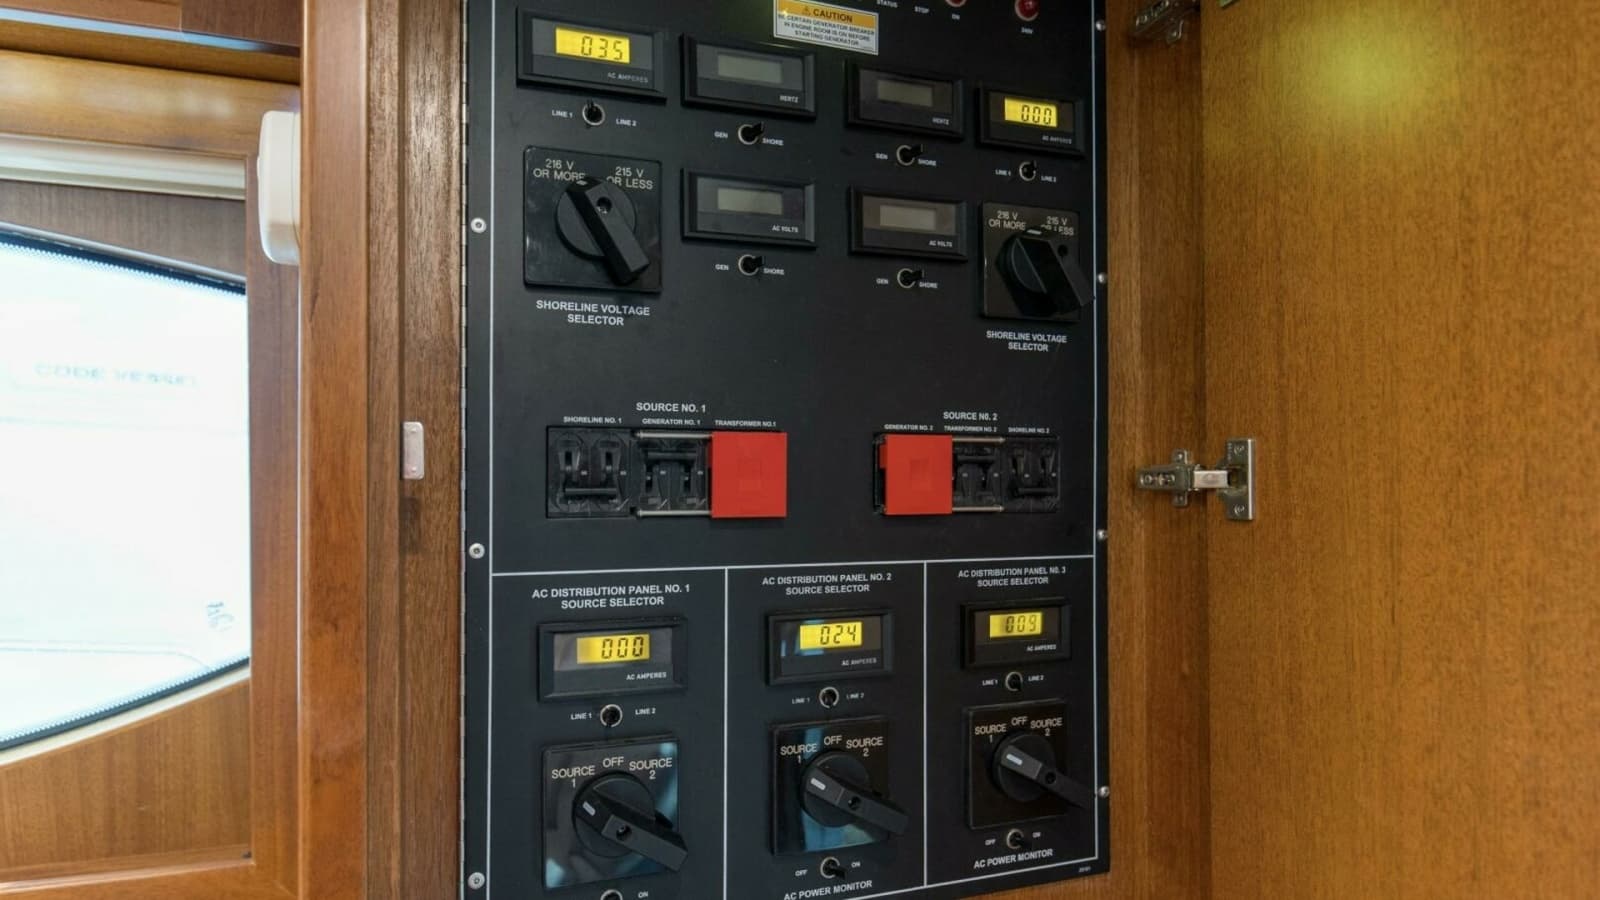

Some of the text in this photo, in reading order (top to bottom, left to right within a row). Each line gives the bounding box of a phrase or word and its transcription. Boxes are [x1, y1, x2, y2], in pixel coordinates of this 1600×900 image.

[813, 8, 853, 22] CAUTION
[786, 16, 875, 36] CERTAIN GENERATOR BREAKER
[792, 23, 812, 31] ENGINE
[813, 26, 830, 34] ROOM
[848, 33, 870, 42] BEFORE
[795, 30, 859, 46] STARTING GENERATOR
[580, 36, 624, 60] 035
[618, 74, 648, 83] AMPERES
[779, 95, 798, 103] HERTZ
[552, 110, 568, 118] LINE
[1020, 104, 1052, 124] 000
[616, 118, 631, 126] LINE
[714, 131, 728, 139] GEN
[762, 137, 784, 146] SHORE
[566, 161, 574, 171] V
[918, 158, 937, 167] SHORE
[533, 168, 550, 179] OR
[615, 166, 644, 178] 215 V
[626, 178, 654, 190] LESS
[1012, 212, 1018, 220] V
[988, 219, 1026, 230] OR MORE
[764, 268, 784, 276] SHORE
[536, 300, 650, 316] SHORELINE VOLTAGE
[568, 314, 624, 326] SELECTOR
[986, 330, 1068, 344] SHORELINE VOLTAGE
[1008, 342, 1049, 352] SELECTOR
[636, 402, 706, 413] SOURCE NO. 1
[943, 411, 998, 421] SOURCE NO. 2
[958, 569, 970, 578] AC
[971, 568, 1022, 578] DISTRIBUTION
[1024, 566, 1048, 576] PANEL
[762, 572, 892, 586] AC DISTRIBUTION PANEL NO. 2
[977, 576, 1049, 587] SOURCE SELECTOR
[532, 584, 690, 598] AC DISTRIBUTION PANEL NO. 1
[786, 584, 870, 596] SOURCE SELECTOR
[561, 596, 664, 609] SOURCE SELECTOR
[820, 624, 857, 646] 024
[601, 636, 645, 660] 000
[851, 657, 877, 665] AMPERES
[636, 672, 667, 680] AMPERES
[1011, 716, 1028, 726] OFF
[1030, 717, 1063, 730] SOURCE
[974, 724, 1007, 736] SOURCE
[1044, 728, 1050, 736] 2
[824, 734, 843, 746] OFF
[846, 736, 884, 750] SOURCE
[990, 734, 994, 743] 1
[780, 743, 818, 756] SOURCE
[862, 748, 870, 758] 2
[602, 756, 624, 768] OFF
[628, 758, 672, 772] SOURCE
[797, 756, 801, 764] 1
[551, 765, 596, 779] SOURCE
[649, 770, 656, 780] 2
[572, 778, 576, 788] 1
[974, 848, 1054, 870] AC POWER MONITOR
[794, 868, 808, 877] OFF
[784, 880, 873, 900] AC POWER MONITOR
